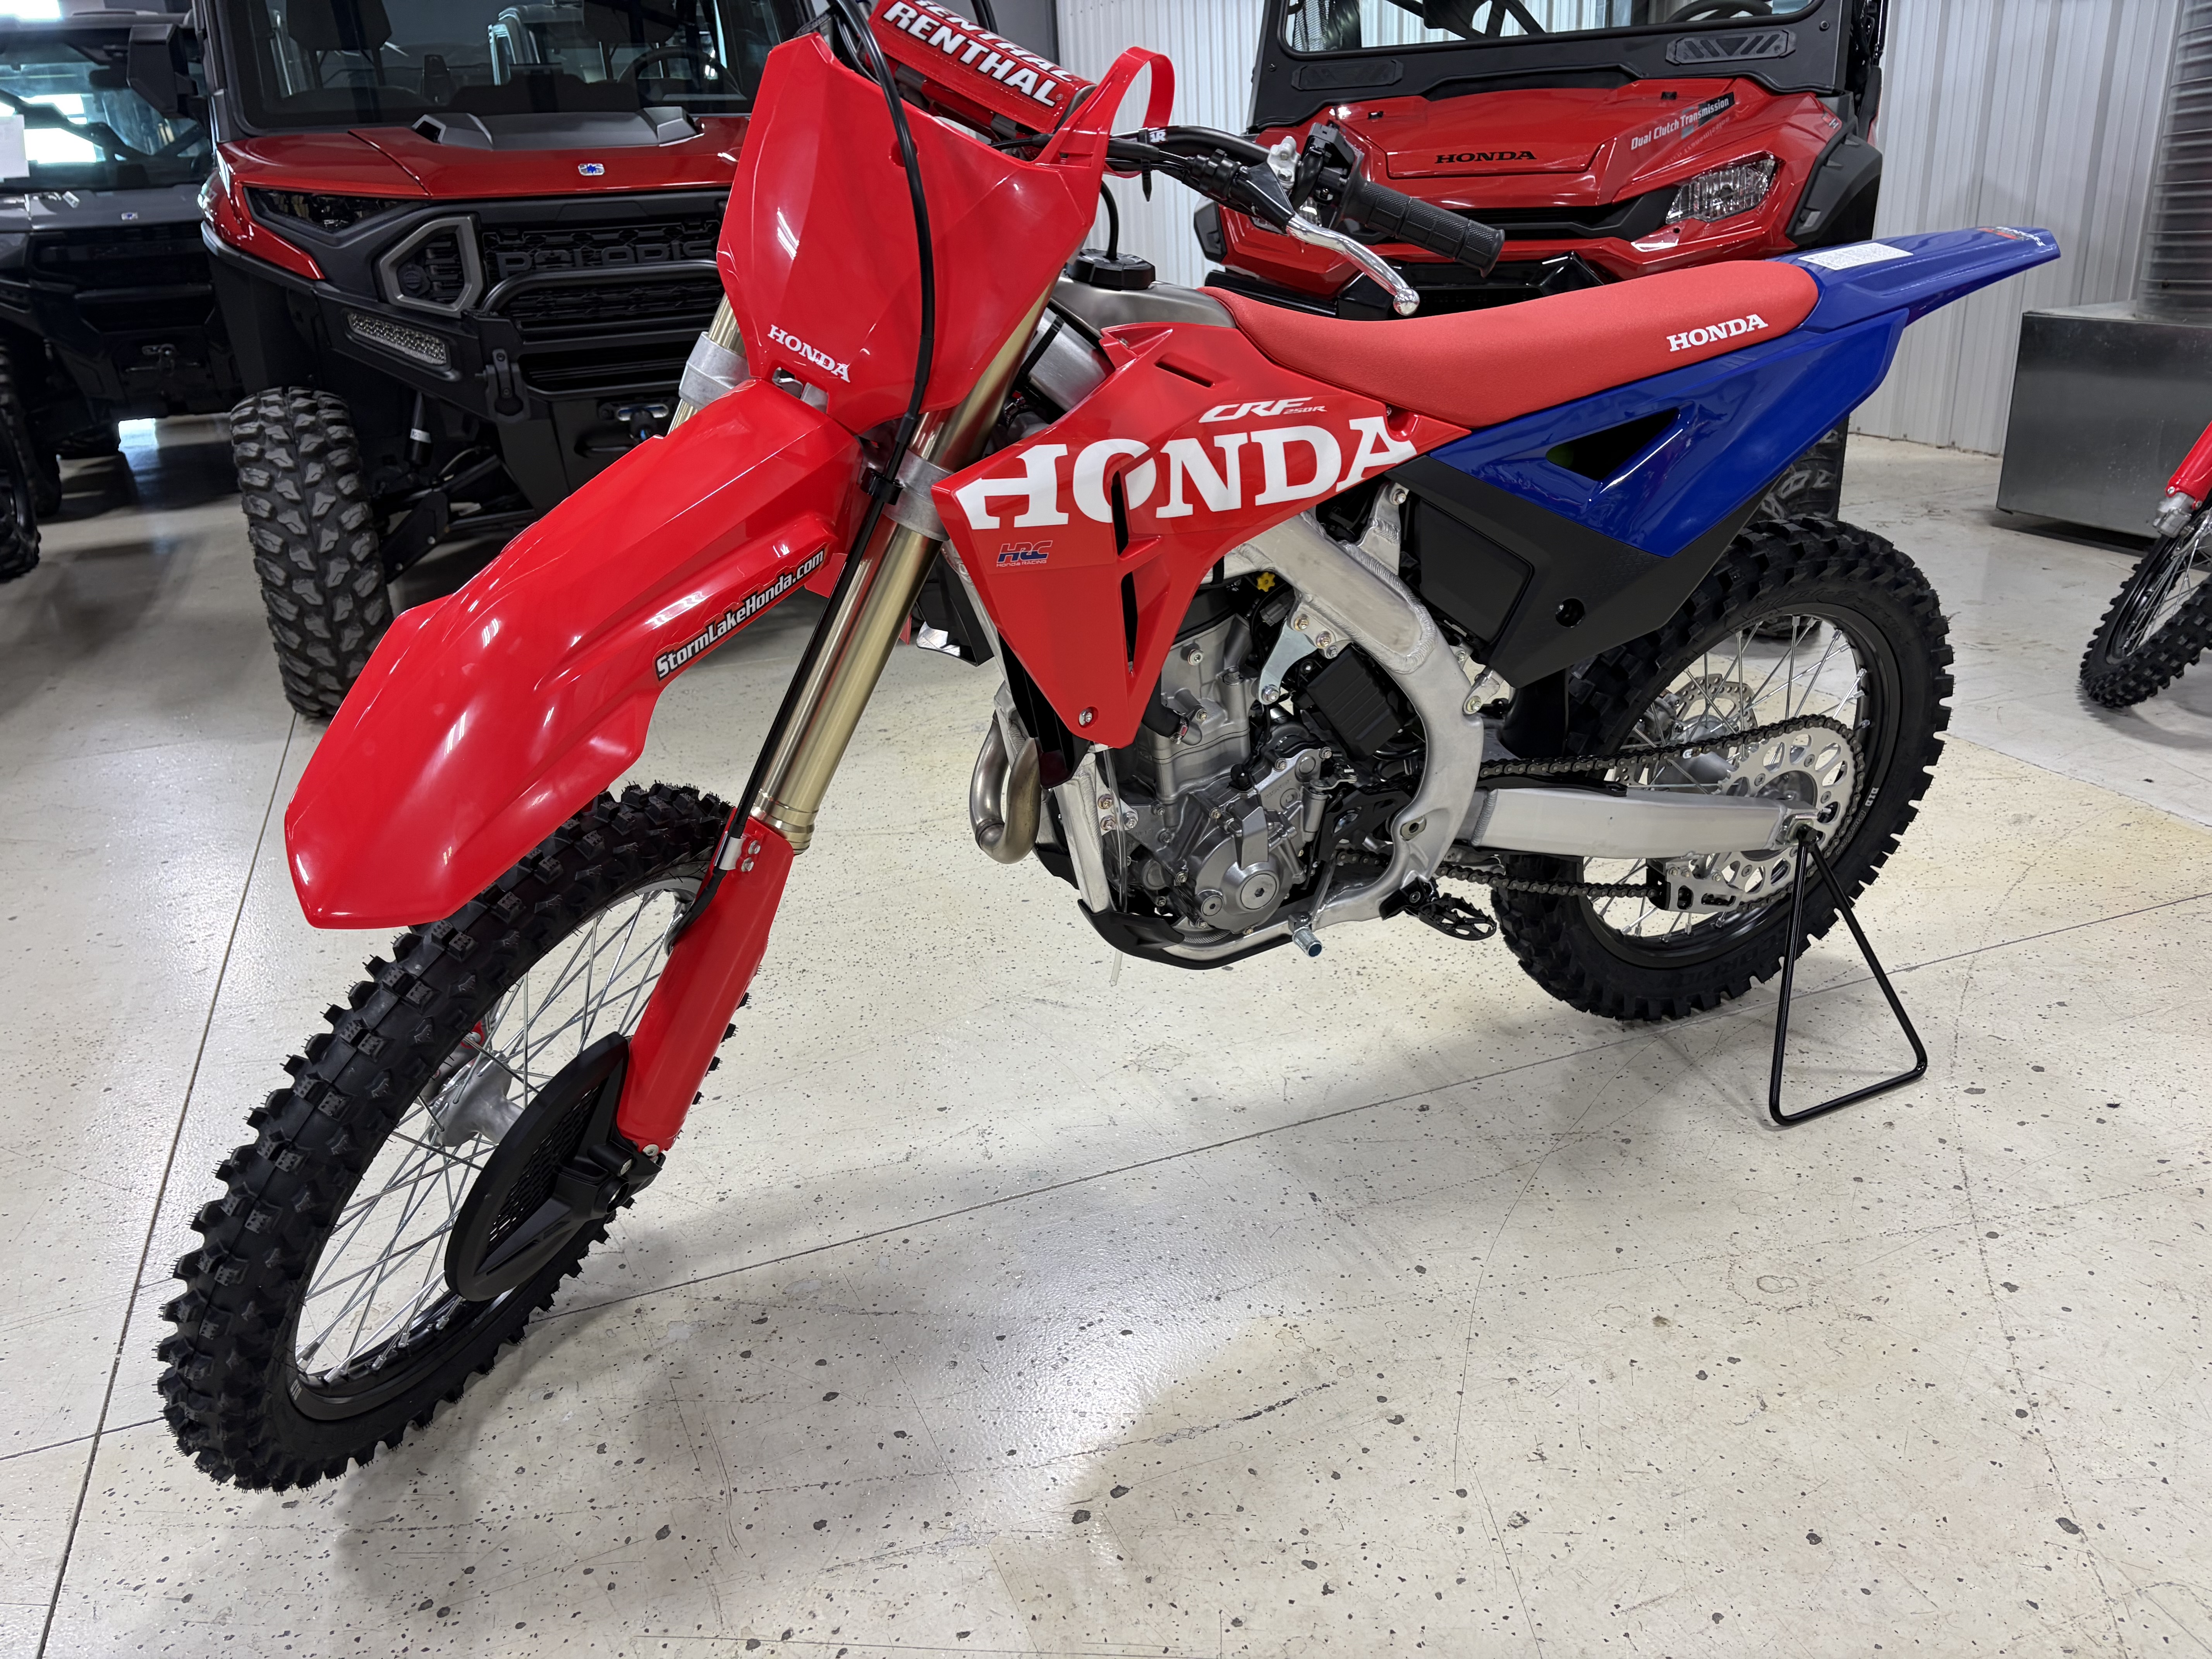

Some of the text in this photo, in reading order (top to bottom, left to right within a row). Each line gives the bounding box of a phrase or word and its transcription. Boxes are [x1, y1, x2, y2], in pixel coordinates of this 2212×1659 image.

[883, 2, 1056, 107] RENTHAL
[1631, 98, 1729, 150] Dual Clutch Transmission
[1434, 151, 1537, 164] HONDA
[767, 324, 851, 383] HONDA
[1666, 314, 1769, 352] HONDA
[1198, 397, 1328, 423] CRF 250R
[955, 416, 1417, 530] HONDA
[996, 540, 1053, 563] HRC
[657, 550, 824, 678] StormLakeHonda.com
